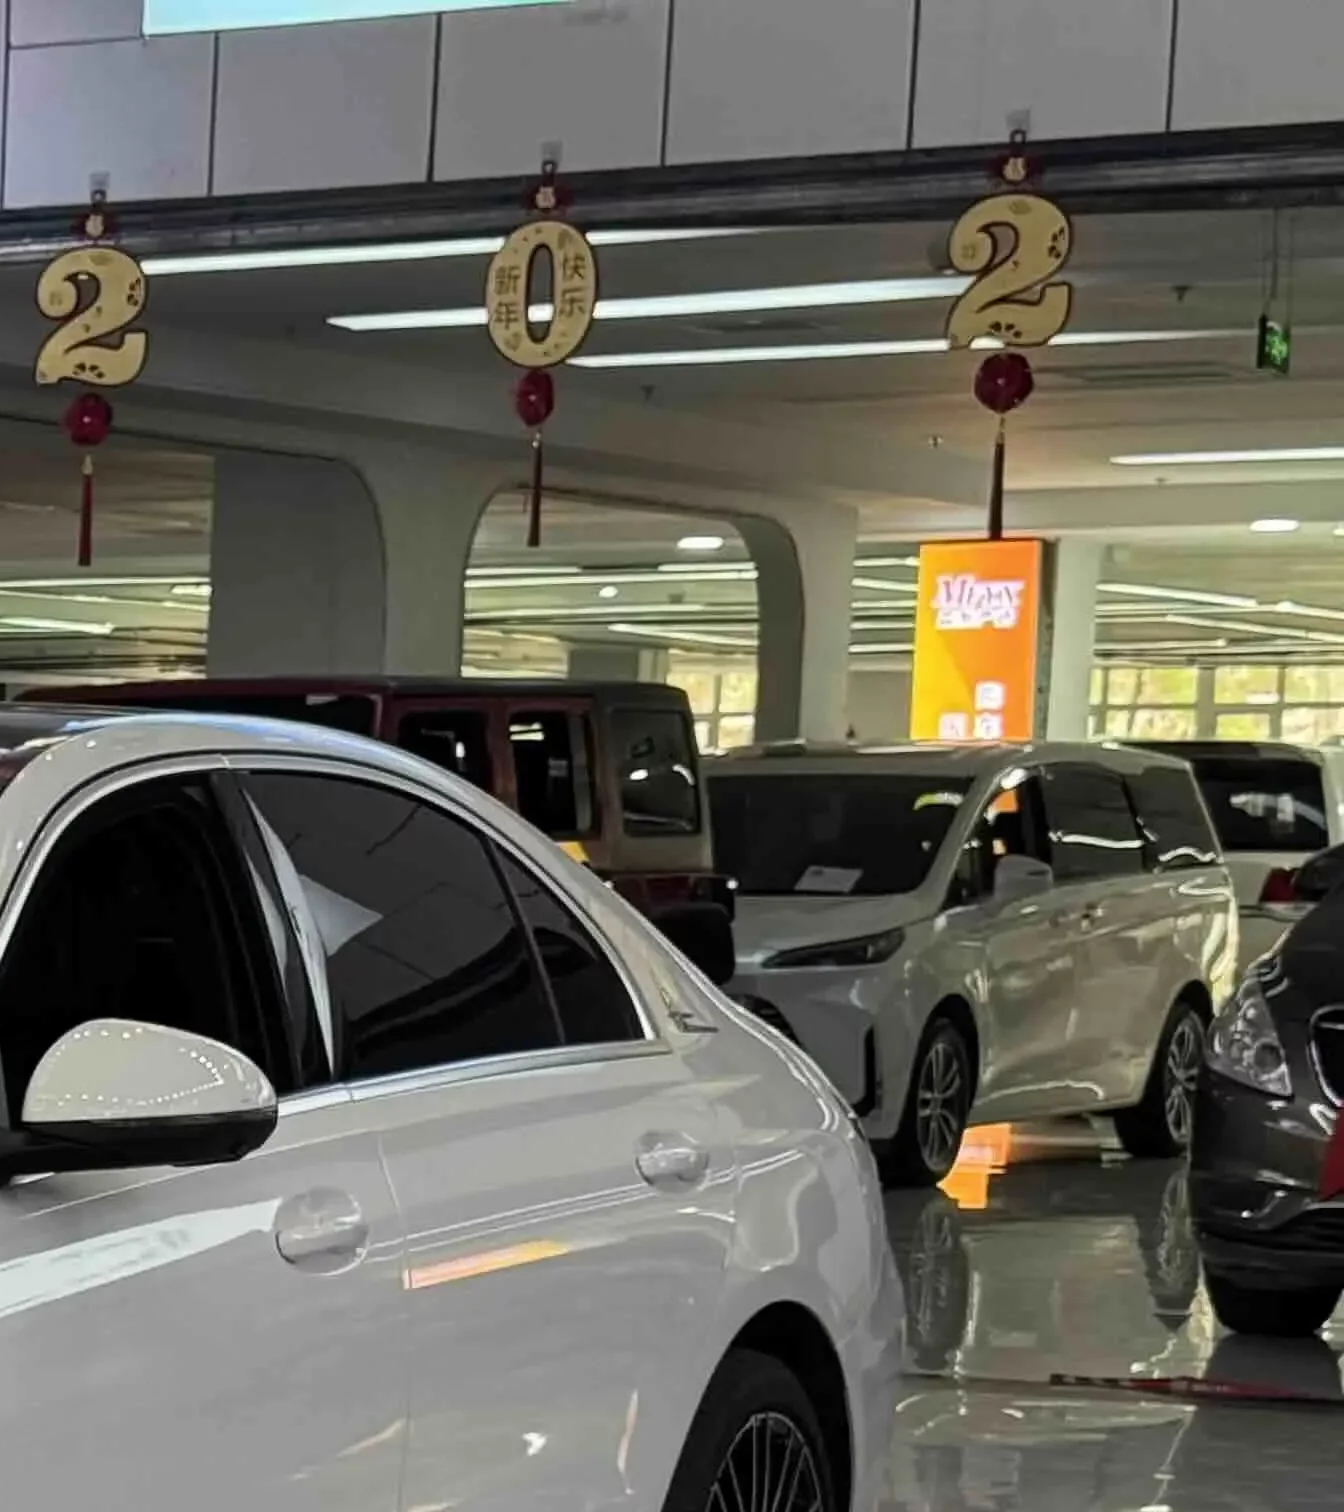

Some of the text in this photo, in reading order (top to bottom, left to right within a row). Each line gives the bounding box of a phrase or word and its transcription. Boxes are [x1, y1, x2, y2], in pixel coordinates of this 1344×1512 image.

[33, 245, 149, 387] 2
[945, 192, 1072, 350] 2
[493, 265, 521, 330] 新年
[559, 252, 587, 319] 快乐
